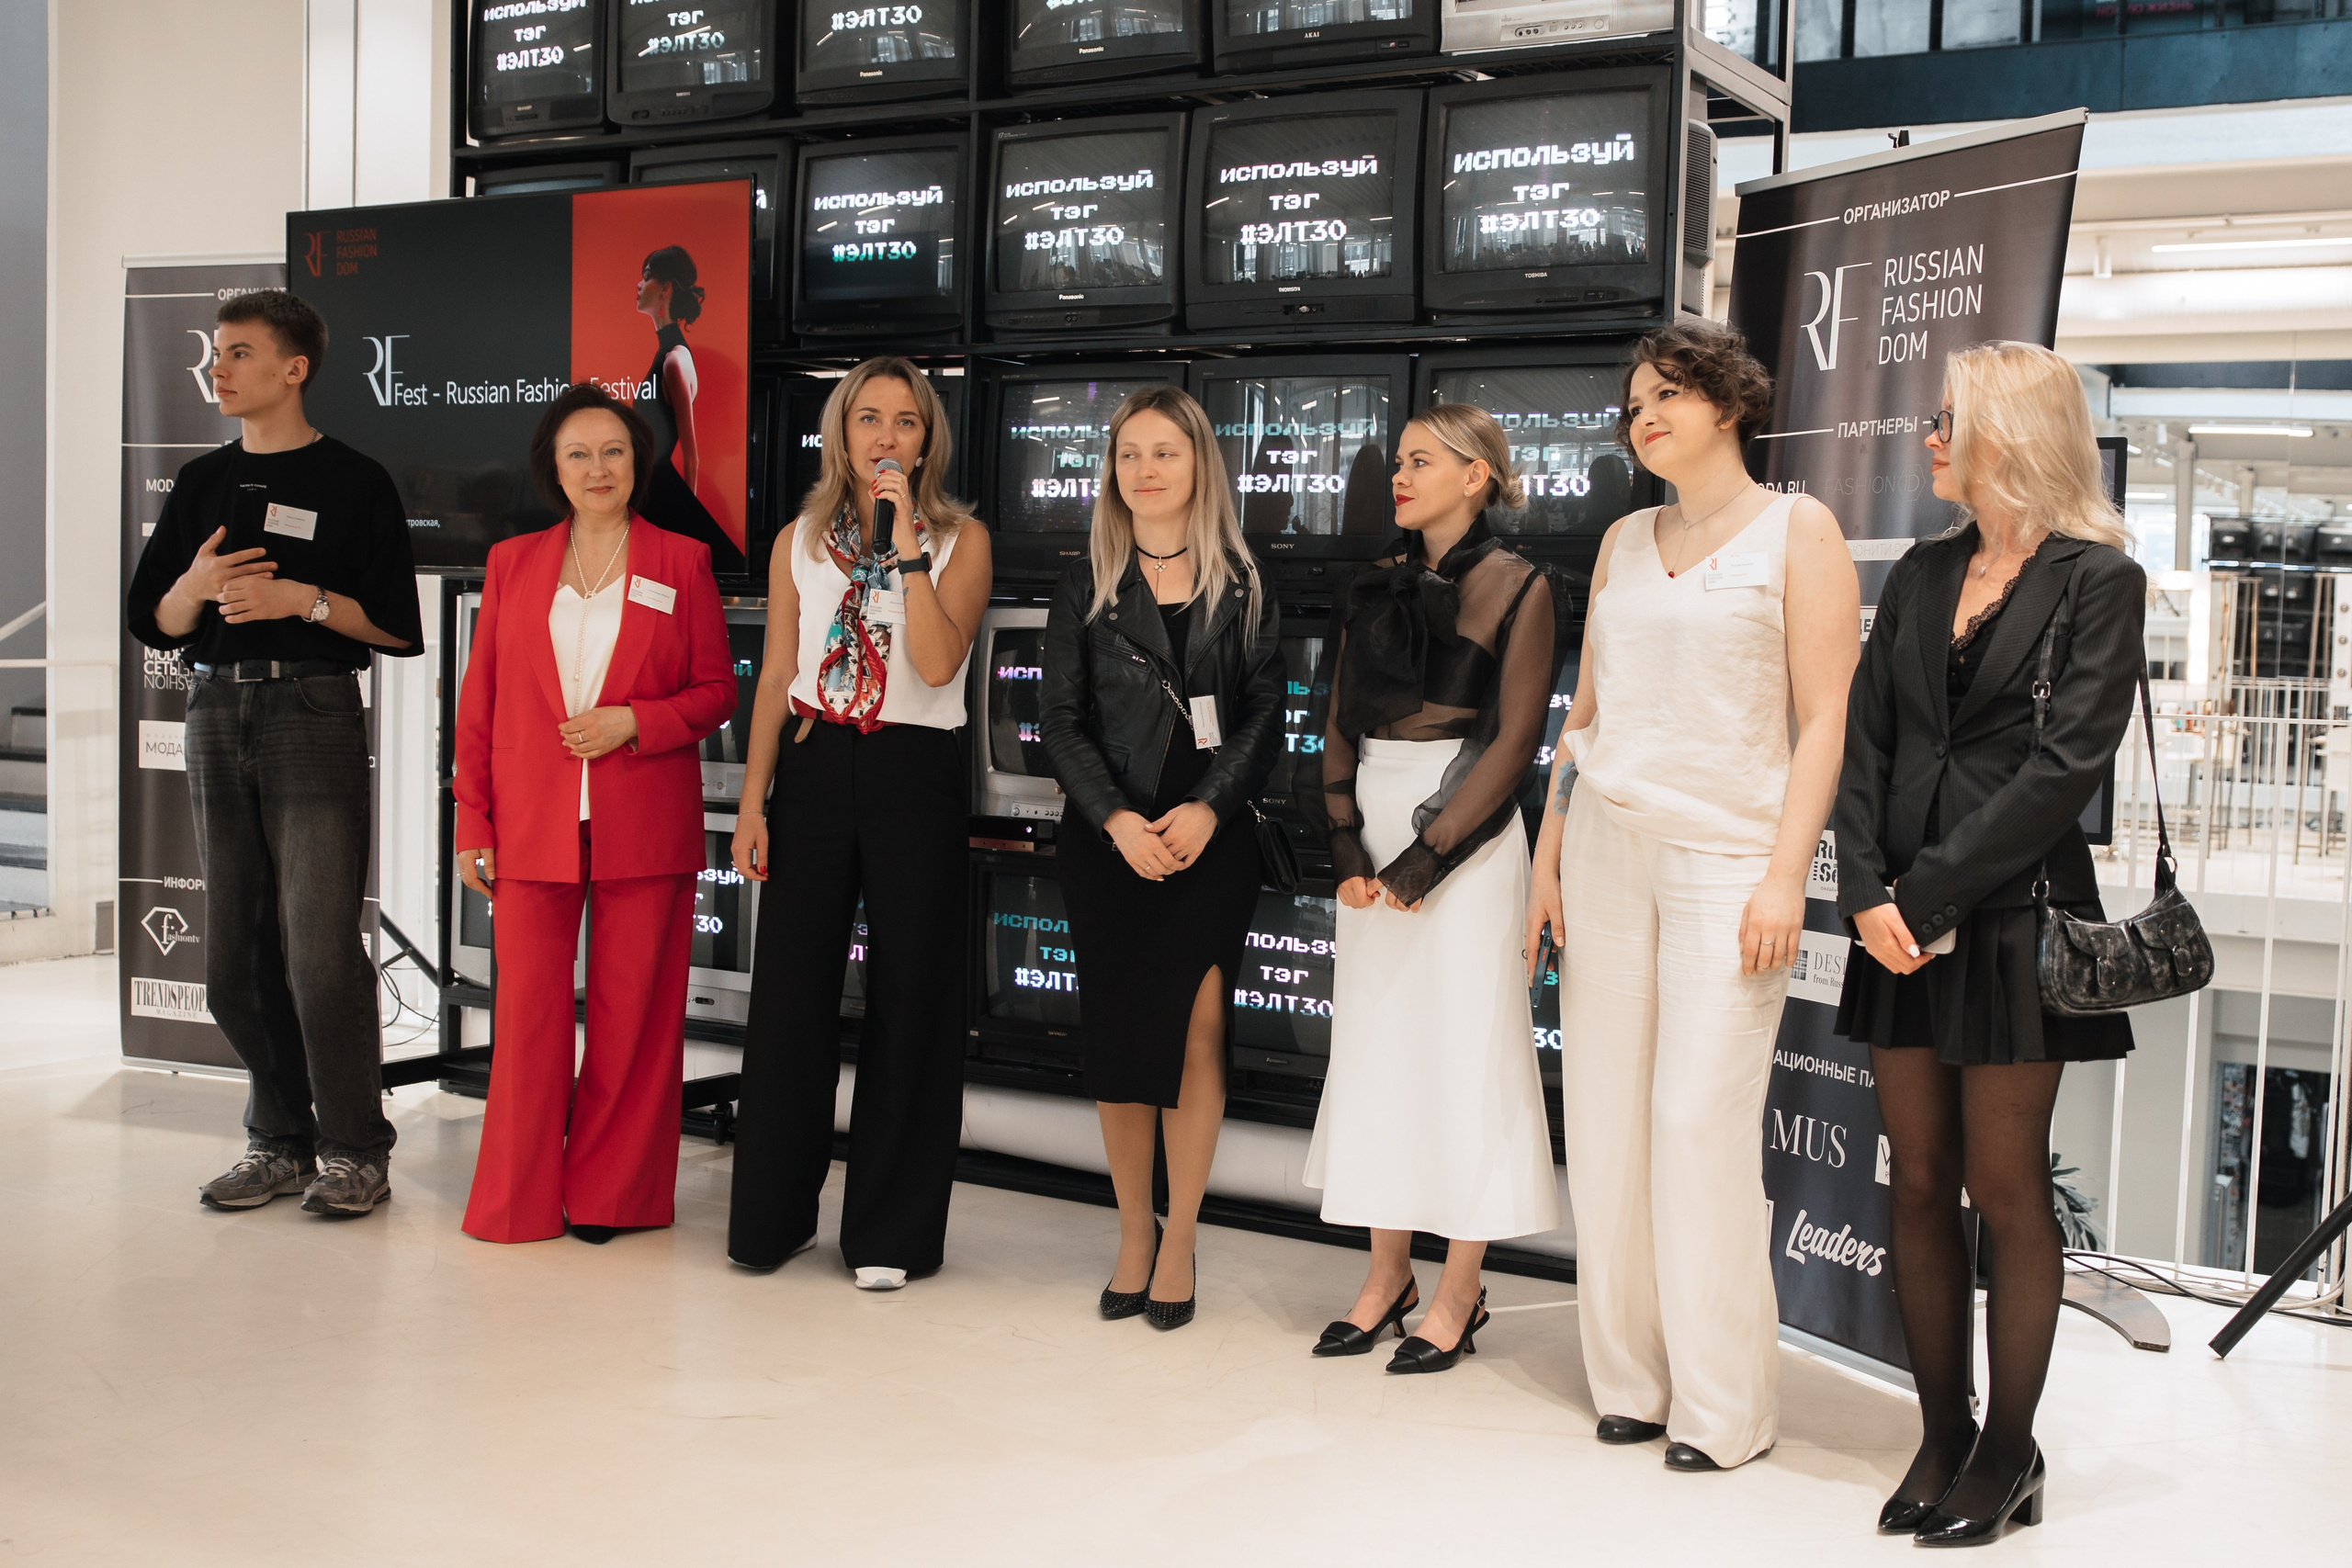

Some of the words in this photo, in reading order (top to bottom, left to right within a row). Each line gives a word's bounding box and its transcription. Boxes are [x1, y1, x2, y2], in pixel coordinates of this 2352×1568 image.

[1304, 30, 1320, 39] AKAI
[1079, 46, 1104, 54] Panasonic
[1843, 189, 1951, 225] ОРГАНИЗАТОР
[336, 228, 377, 243] RUSSIAN
[336, 243, 378, 259] FASHION
[336, 261, 358, 276] DOM
[1883, 243, 1984, 288] RUSSIAN
[1881, 284, 1983, 327] FASHION
[1878, 330, 1928, 366] DOM
[447, 379, 510, 405] Russian
[1838, 416, 1917, 438] ПАРТНЕРЫ
[1825, 475, 1895, 496] FASHION
[164, 875, 206, 891] ИНФОР
[1014, 966, 1079, 992] #ЭЛТ
[1813, 974, 1828, 986] from
[134, 980, 209, 1013] TRENDSPEOP
[155, 1008, 198, 1020] MAGAZINE
[1773, 1049, 1856, 1084] АЦИОННЫЕ
[1770, 1108, 1848, 1169] MUS
[1786, 1209, 1886, 1277] Leaders
